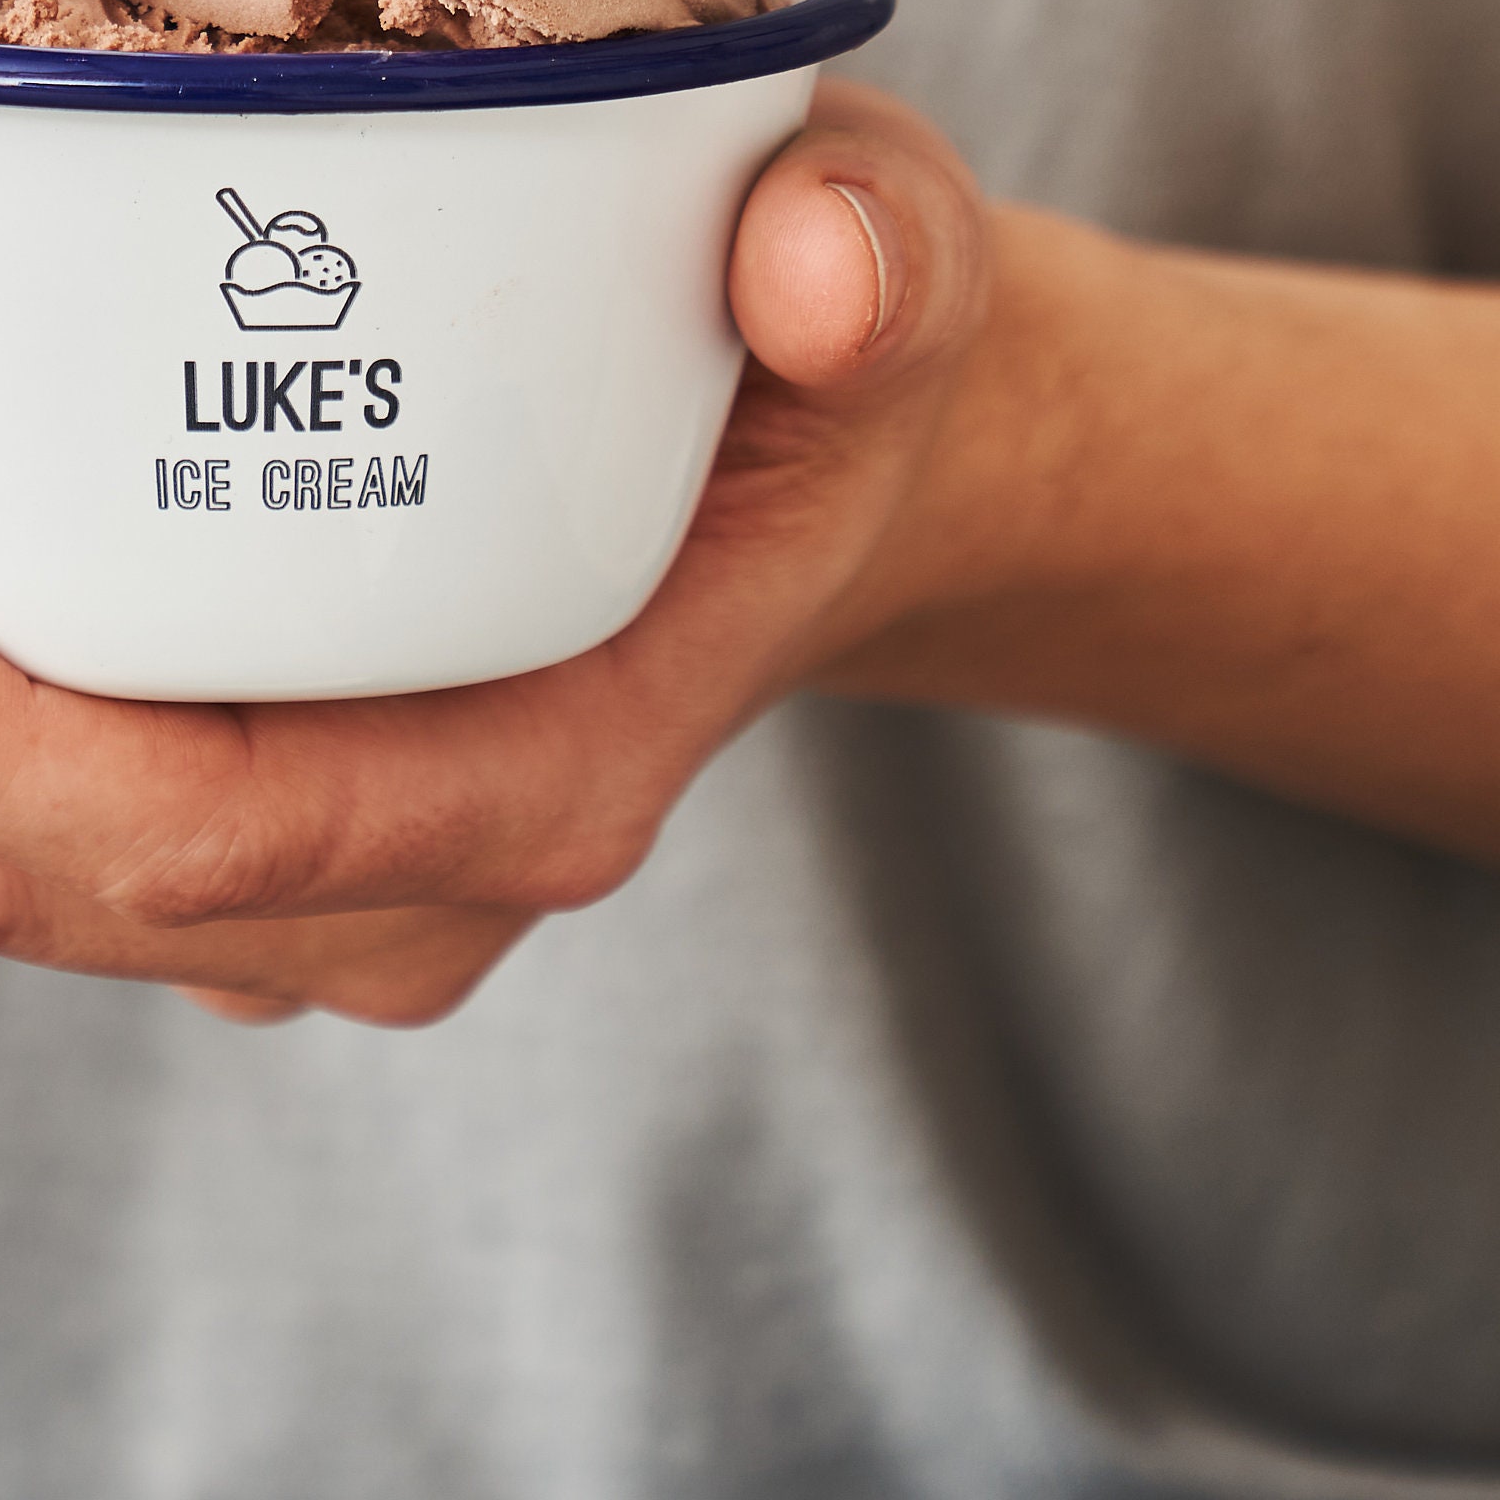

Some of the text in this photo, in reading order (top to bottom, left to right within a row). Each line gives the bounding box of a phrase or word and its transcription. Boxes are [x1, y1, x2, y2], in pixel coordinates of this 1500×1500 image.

[183, 358, 403, 433] LUKE'S
[155, 453, 429, 512] ICE CREAM
